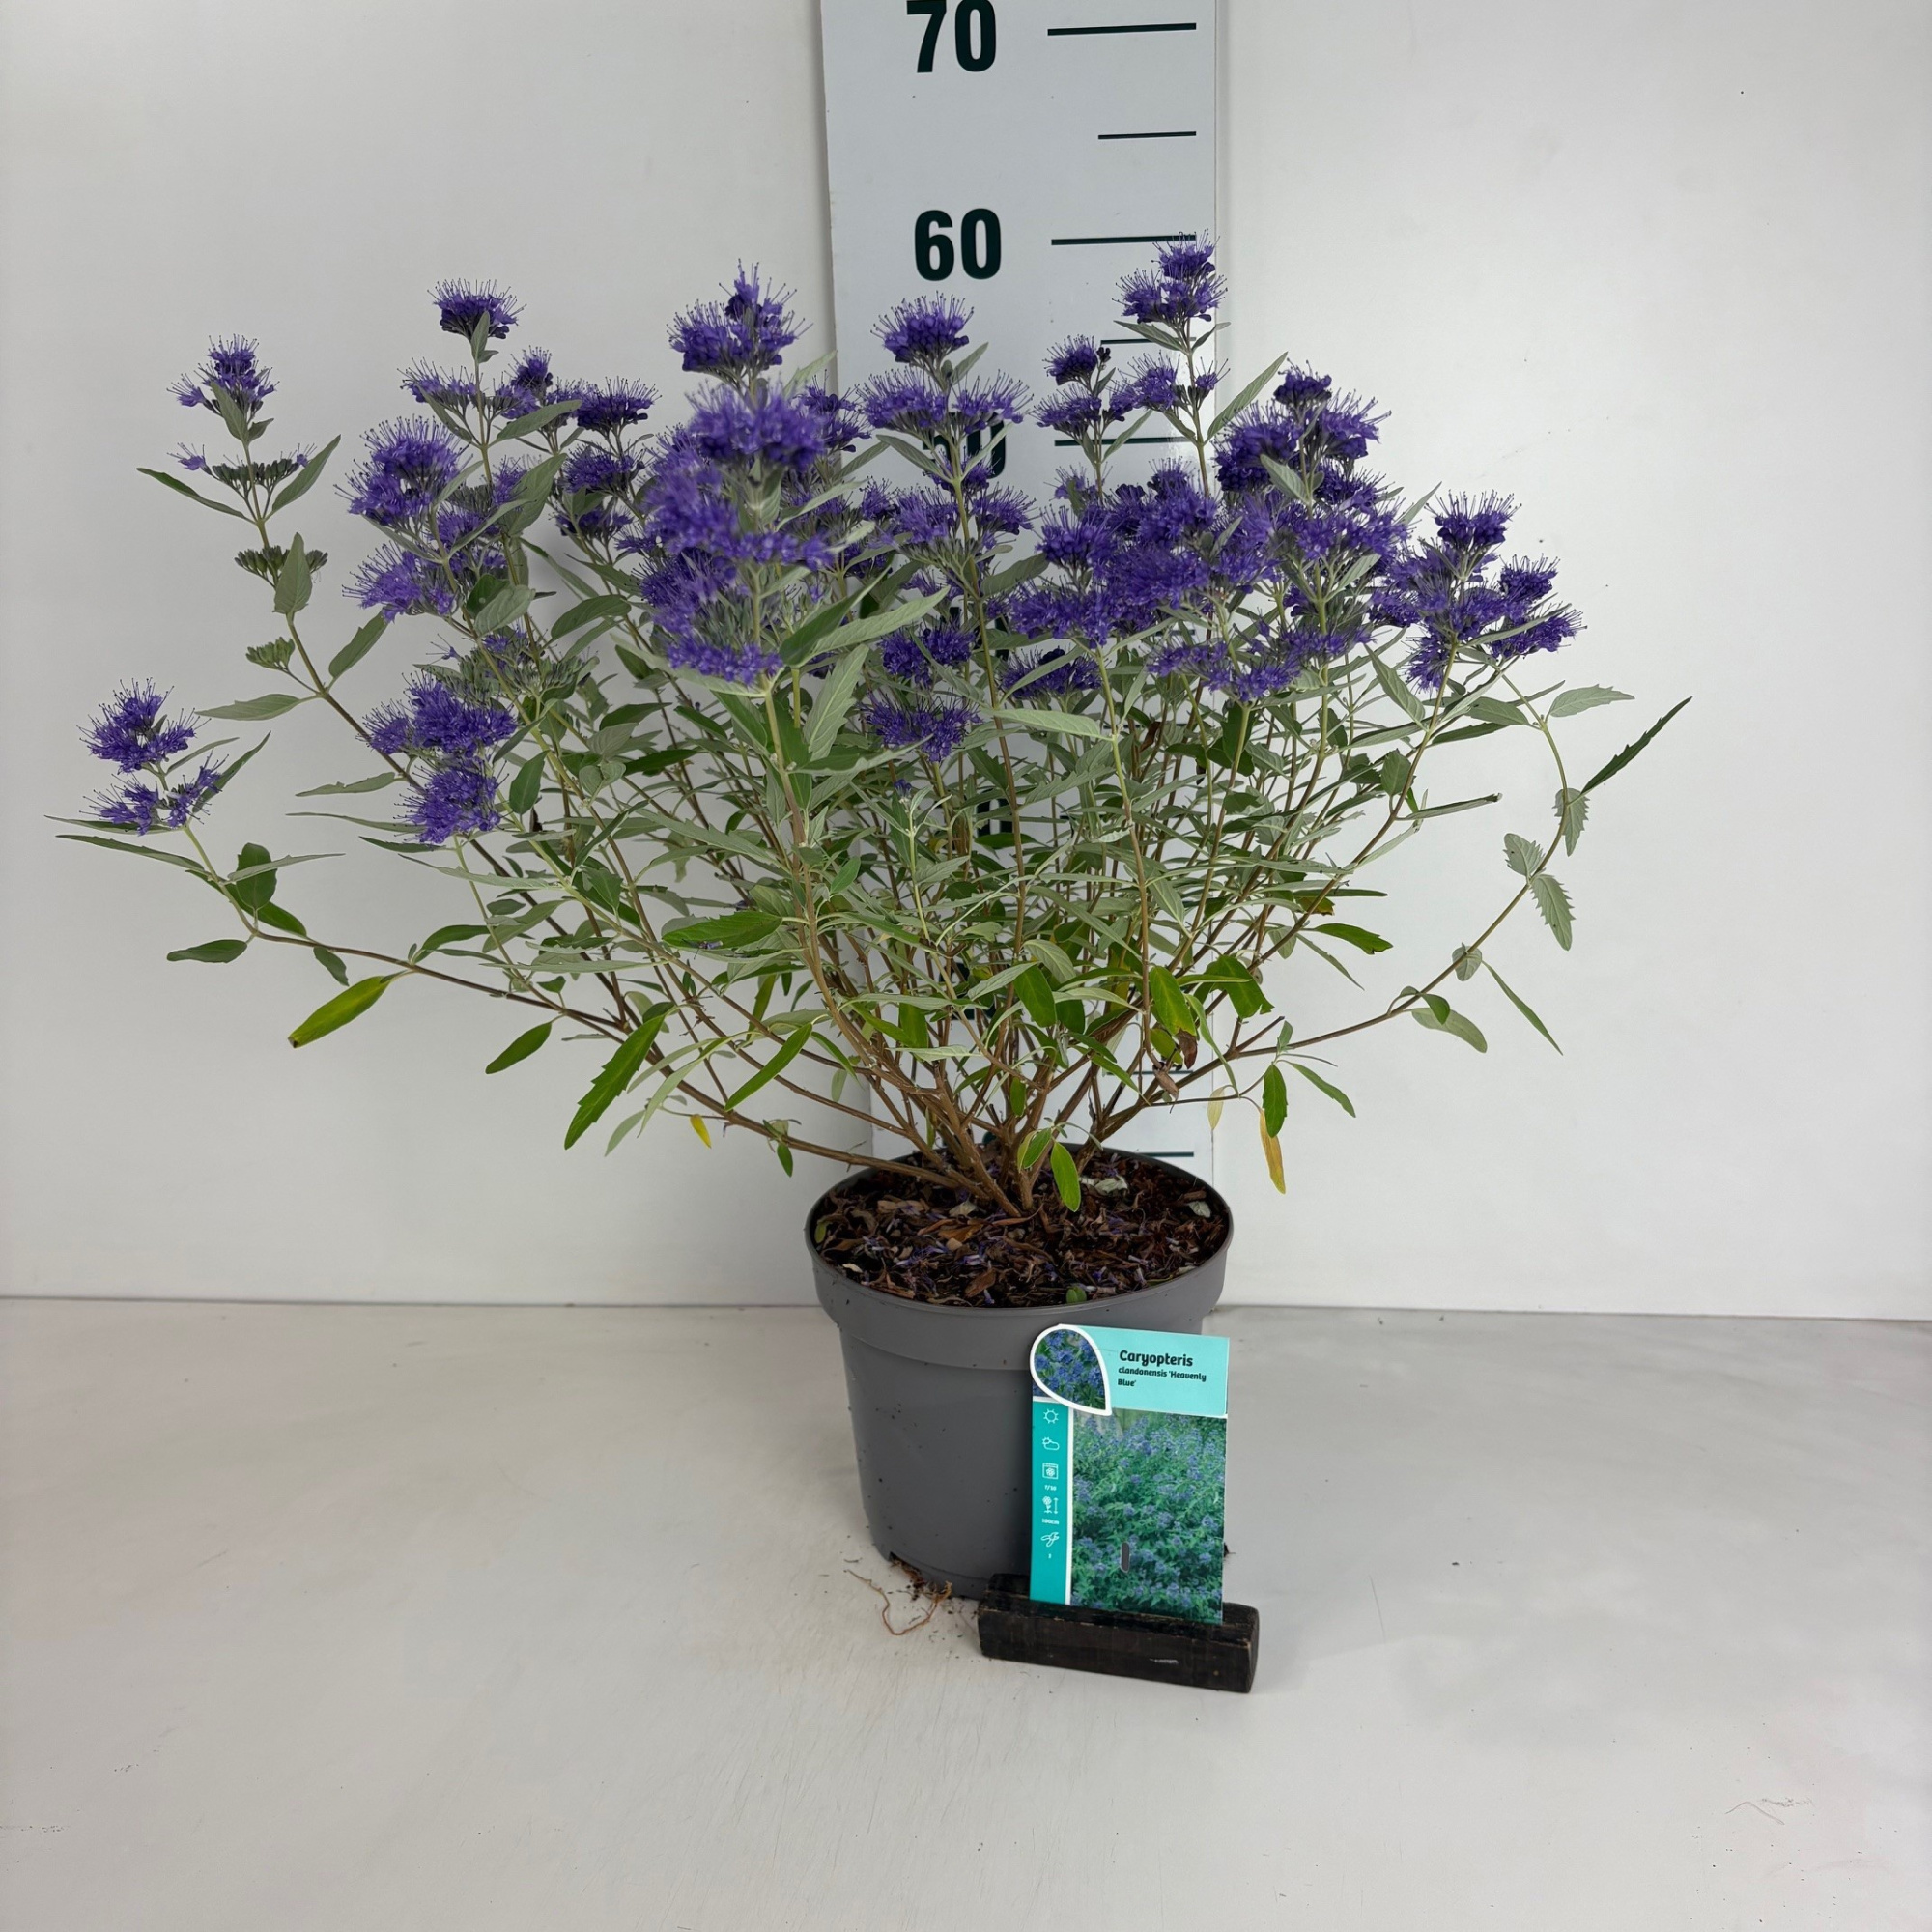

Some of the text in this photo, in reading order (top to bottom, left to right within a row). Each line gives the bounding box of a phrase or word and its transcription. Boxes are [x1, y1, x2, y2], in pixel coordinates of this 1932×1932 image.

[906, 0, 997, 73] 70
[914, 208, 1002, 282] 60
[1118, 1366, 1208, 1382] clandonensis 'Heavenly
[1120, 1350, 1194, 1367] Caryopteris
